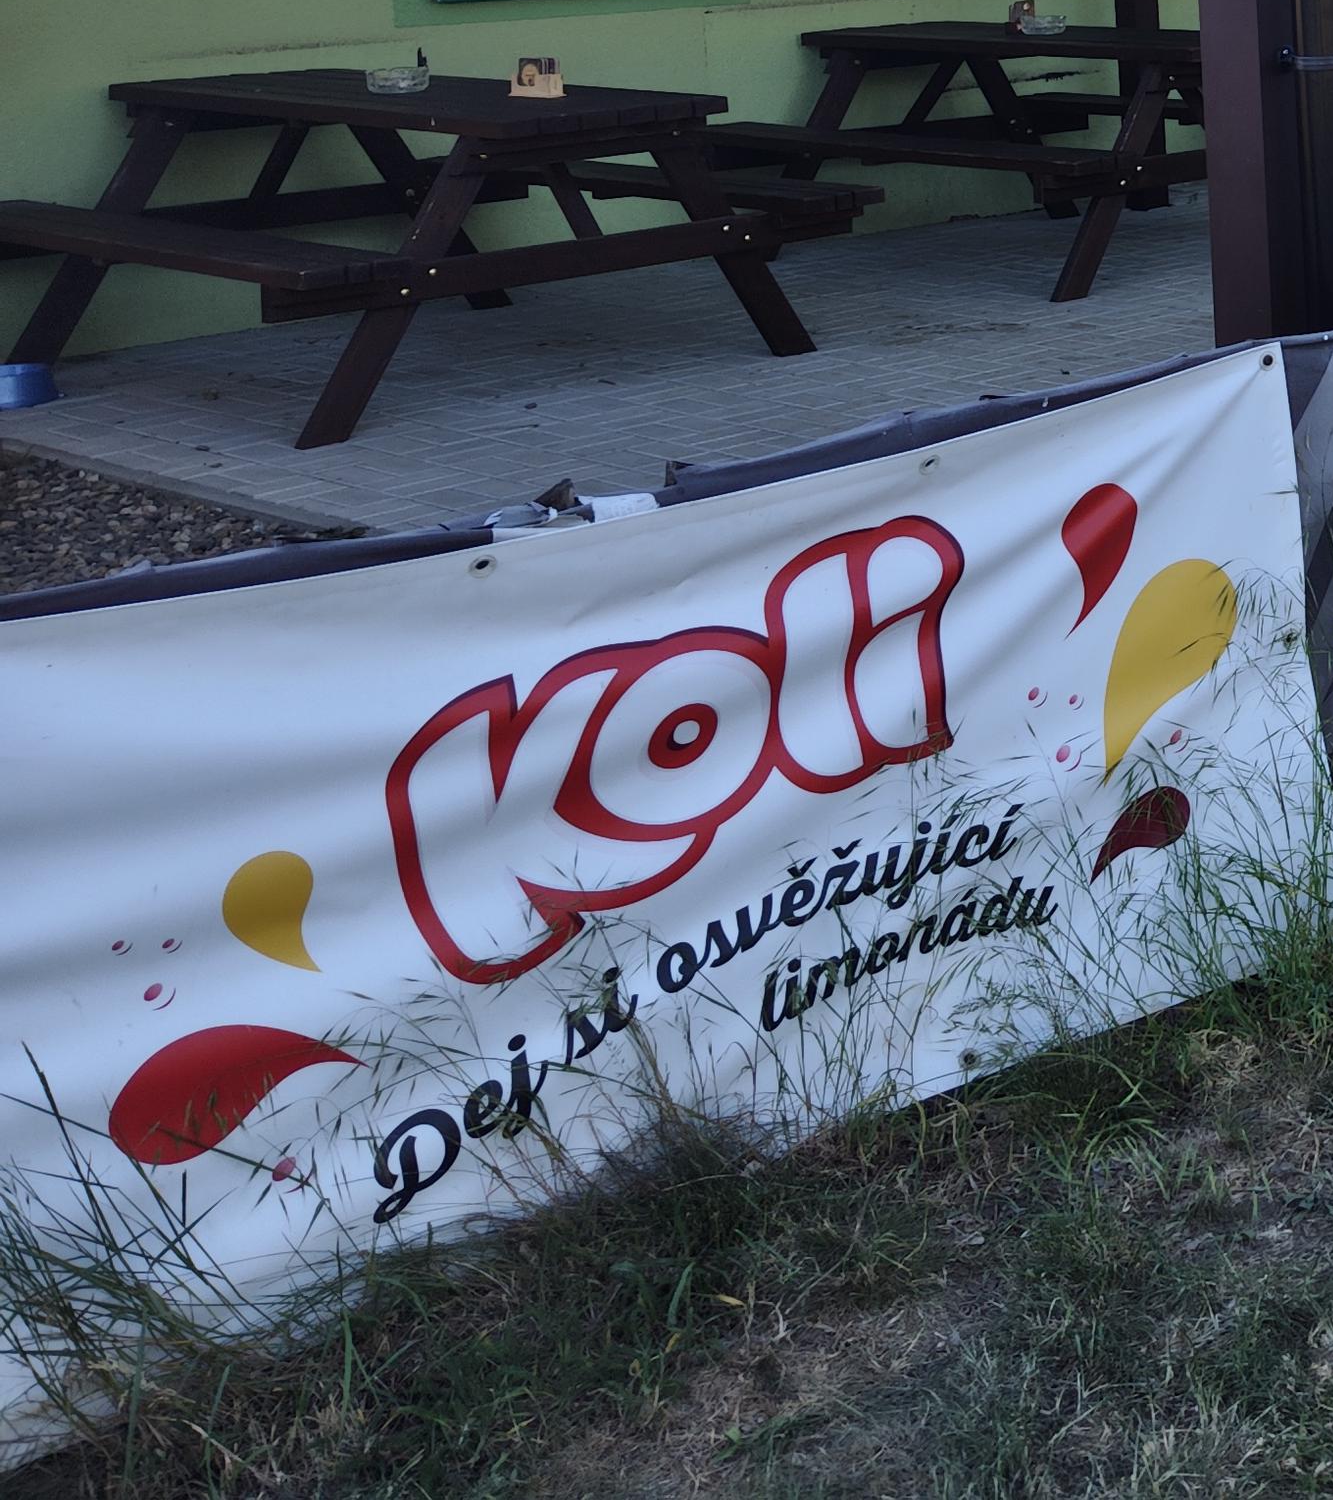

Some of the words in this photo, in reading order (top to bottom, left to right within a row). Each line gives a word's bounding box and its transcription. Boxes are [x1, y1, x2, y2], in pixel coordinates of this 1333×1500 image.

[385, 514, 965, 985] Koli
[760, 876, 1060, 1032] limonádu
[373, 1034, 551, 1224] Dej
[564, 966, 640, 1070] si
[656, 802, 1023, 994] osvěžující
